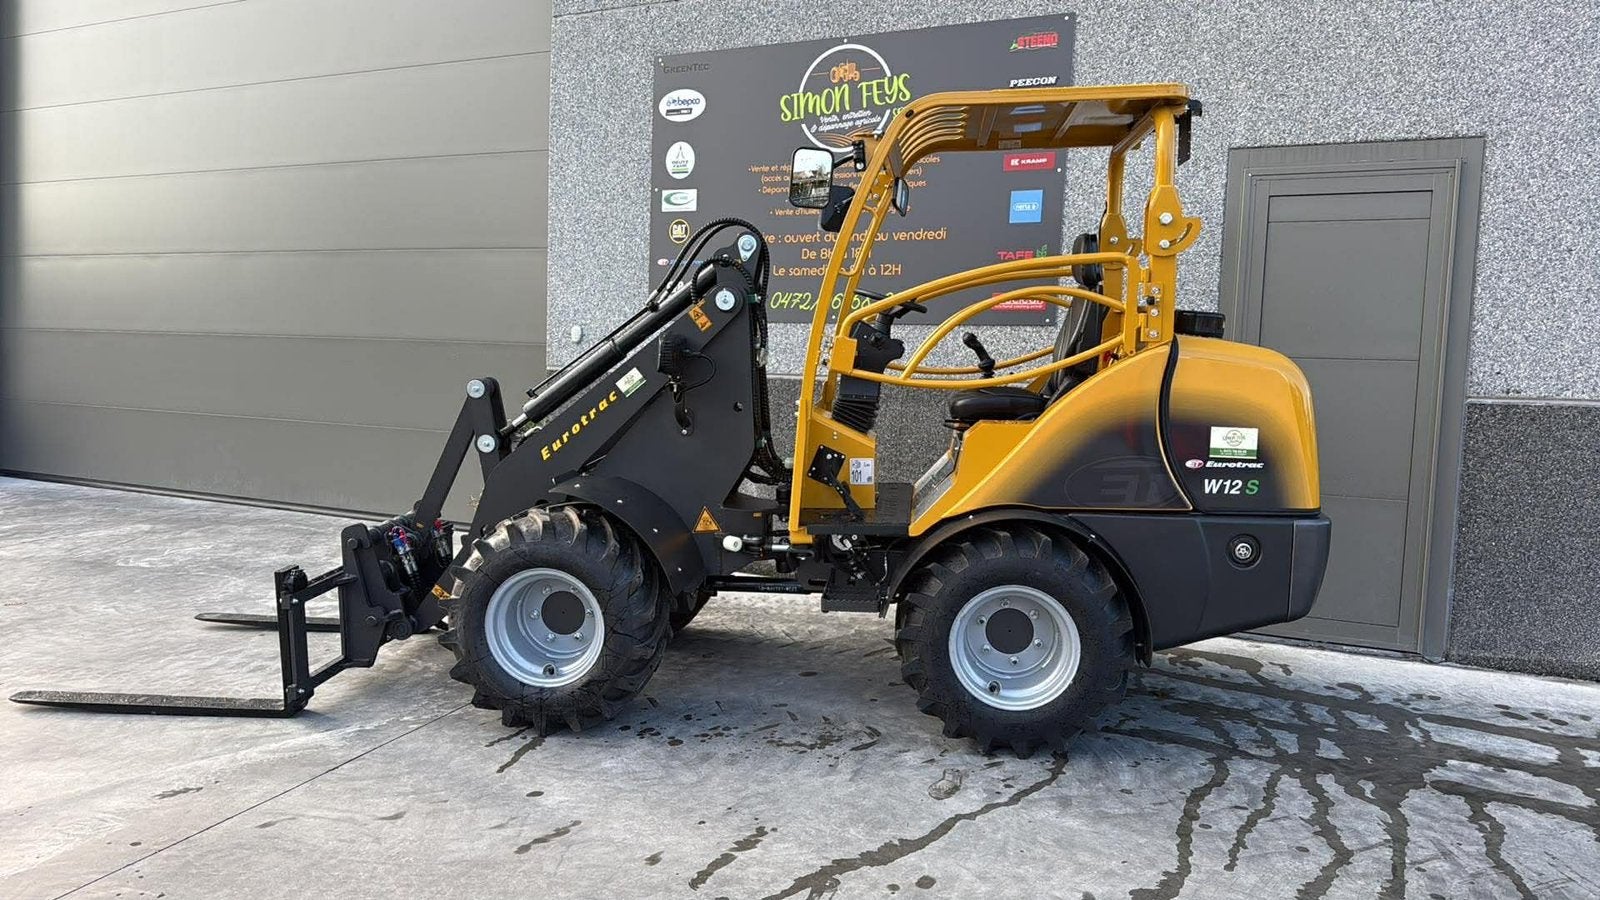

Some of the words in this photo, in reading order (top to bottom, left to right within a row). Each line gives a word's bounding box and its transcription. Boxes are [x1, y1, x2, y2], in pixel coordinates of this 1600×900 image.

[1009, 76, 1058, 88] PEECON
[779, 82, 850, 122] SIMON
[857, 73, 911, 109] FEYS
[672, 224, 687, 236] CAT
[892, 226, 947, 241] vendredi
[784, 231, 821, 244] ouvert
[801, 247, 817, 260] De
[997, 250, 1034, 261] TAFE
[773, 264, 786, 276] Le
[880, 263, 902, 276] 12H
[540, 390, 618, 461] Eurotrac
[1205, 460, 1265, 468] Eurotrac
[852, 469, 862, 483] 101
[1204, 478, 1243, 495] W12
[1245, 479, 1260, 495] S
